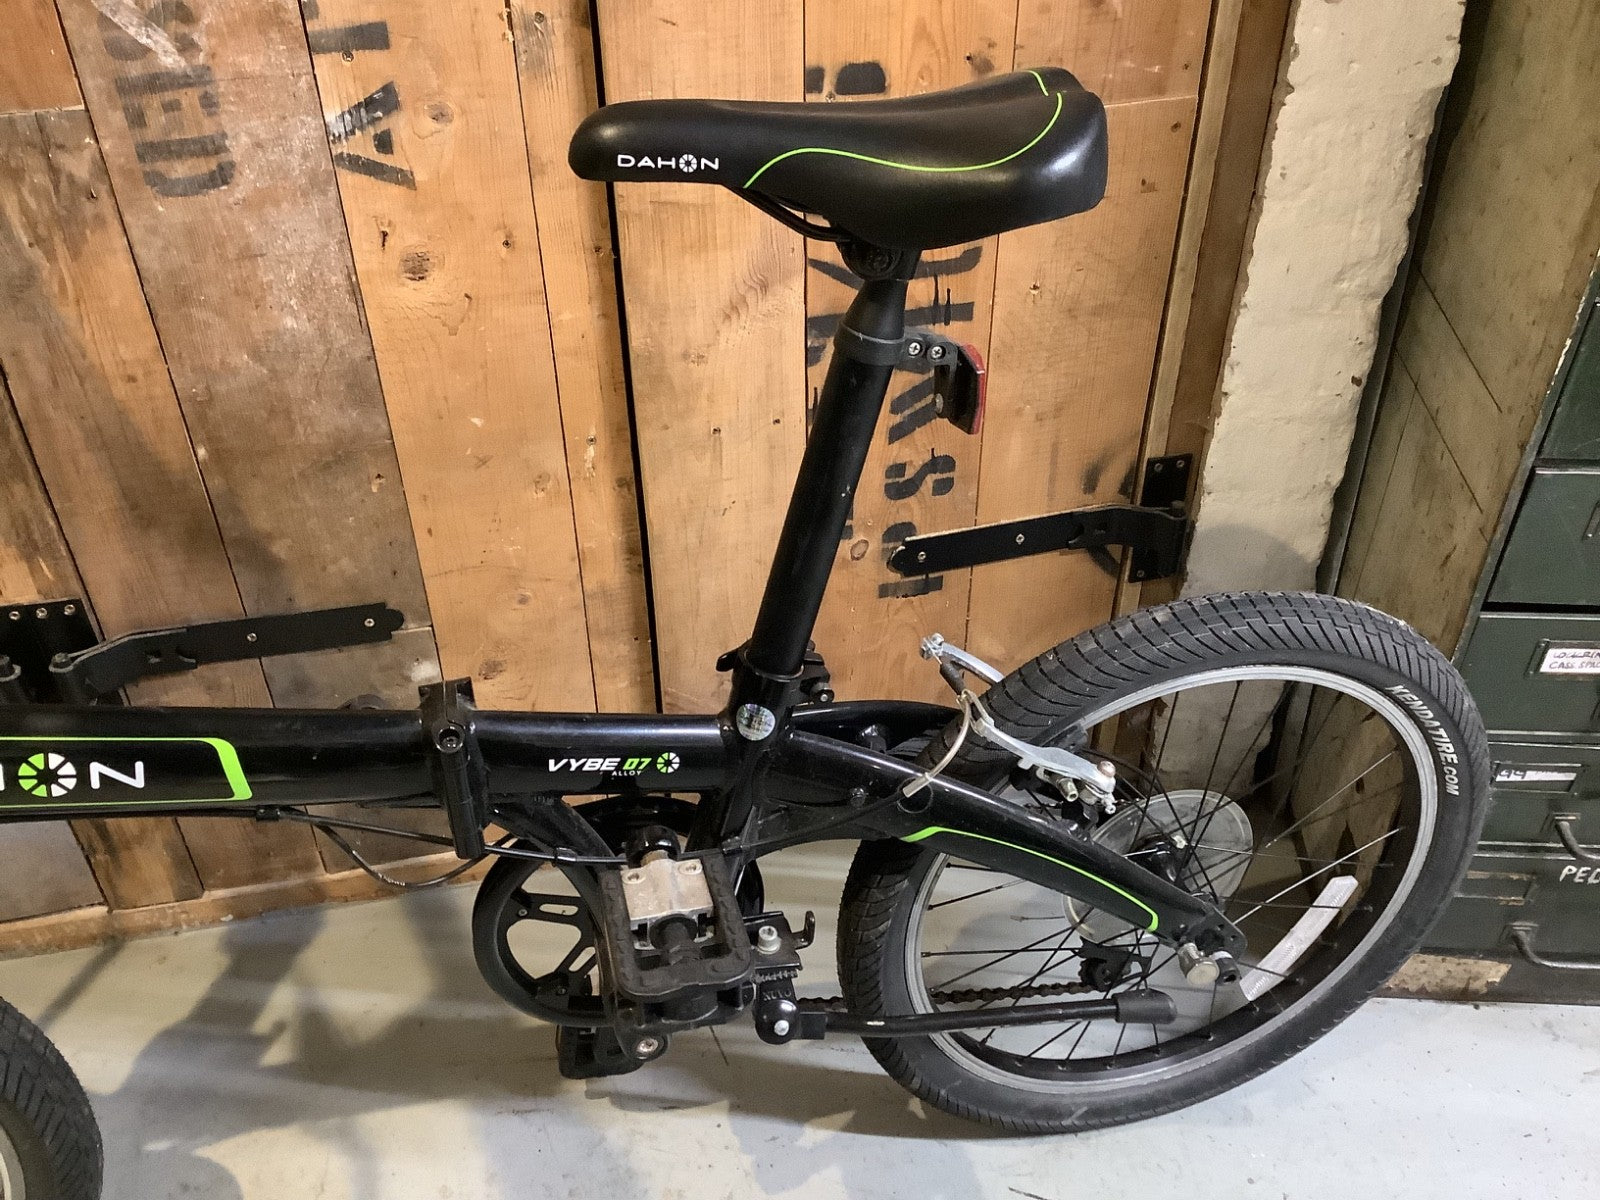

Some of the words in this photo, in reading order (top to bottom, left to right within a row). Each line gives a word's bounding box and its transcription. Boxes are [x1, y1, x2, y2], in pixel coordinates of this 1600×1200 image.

[617, 154, 719, 173] DAHON
[1385, 684, 1459, 796] KENDATIRE.COM
[0, 752, 145, 797] ON
[548, 757, 622, 772] VYBE
[622, 757, 652, 770] 07
